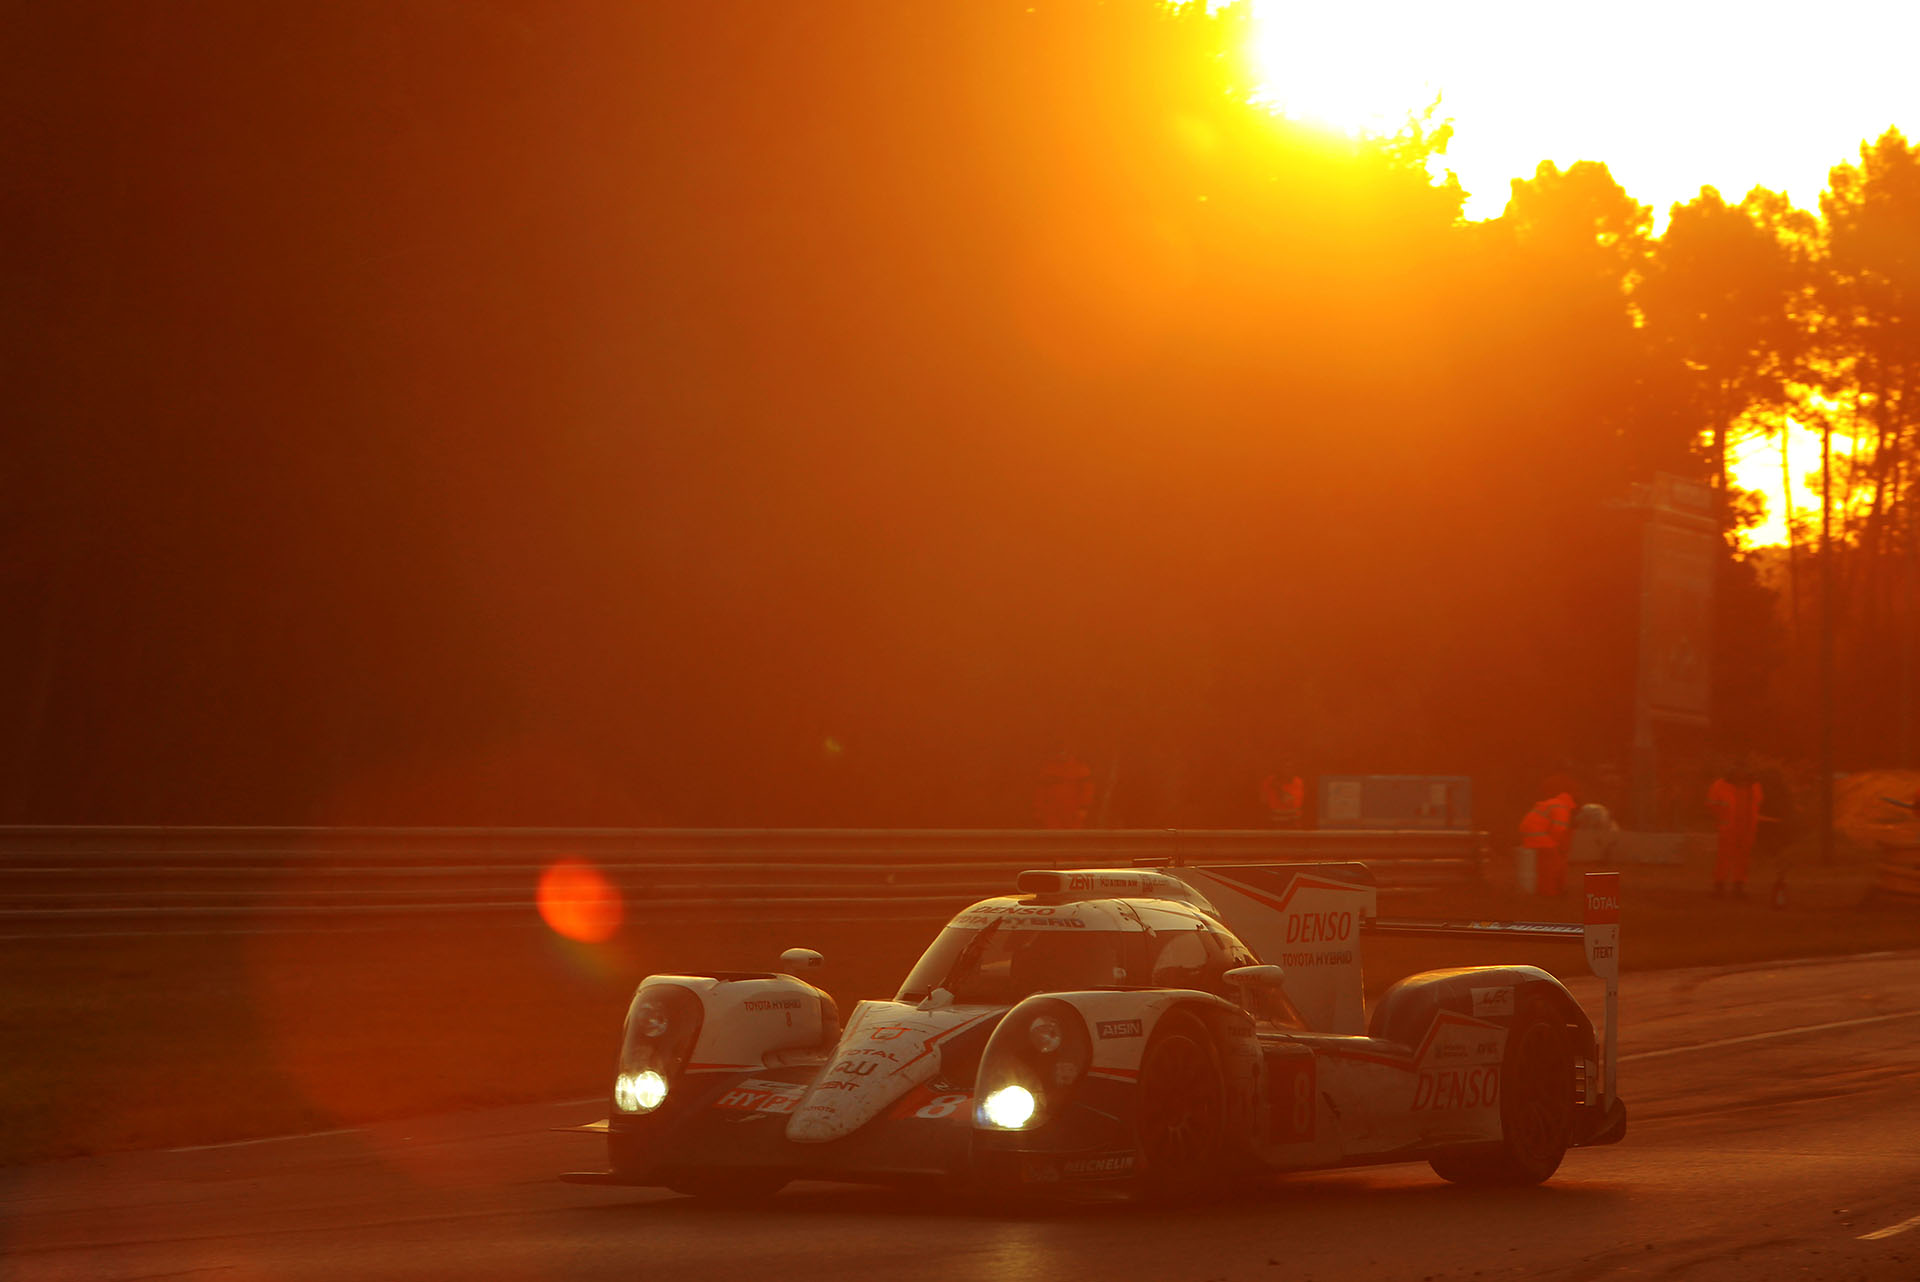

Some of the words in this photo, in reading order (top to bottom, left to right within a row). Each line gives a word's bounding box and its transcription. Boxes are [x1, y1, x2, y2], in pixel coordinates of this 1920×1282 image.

[1586, 893, 1620, 910] TOTAL
[971, 905, 1056, 916] DENSO
[1000, 917, 1086, 929] HYBRID
[1286, 912, 1352, 944] DENSO
[1282, 953, 1314, 967] TOYOTA
[1315, 951, 1352, 966] HYBRID
[744, 1001, 772, 1012] TOYOTA
[773, 998, 801, 1010] HYBRID
[1102, 1021, 1141, 1036] AISIN
[840, 1048, 900, 1063] OTAL
[1410, 1068, 1499, 1112] DENSO
[915, 1094, 968, 1119] 8
[1294, 1071, 1311, 1134] 8
[1064, 1156, 1136, 1172] MICHELIN
